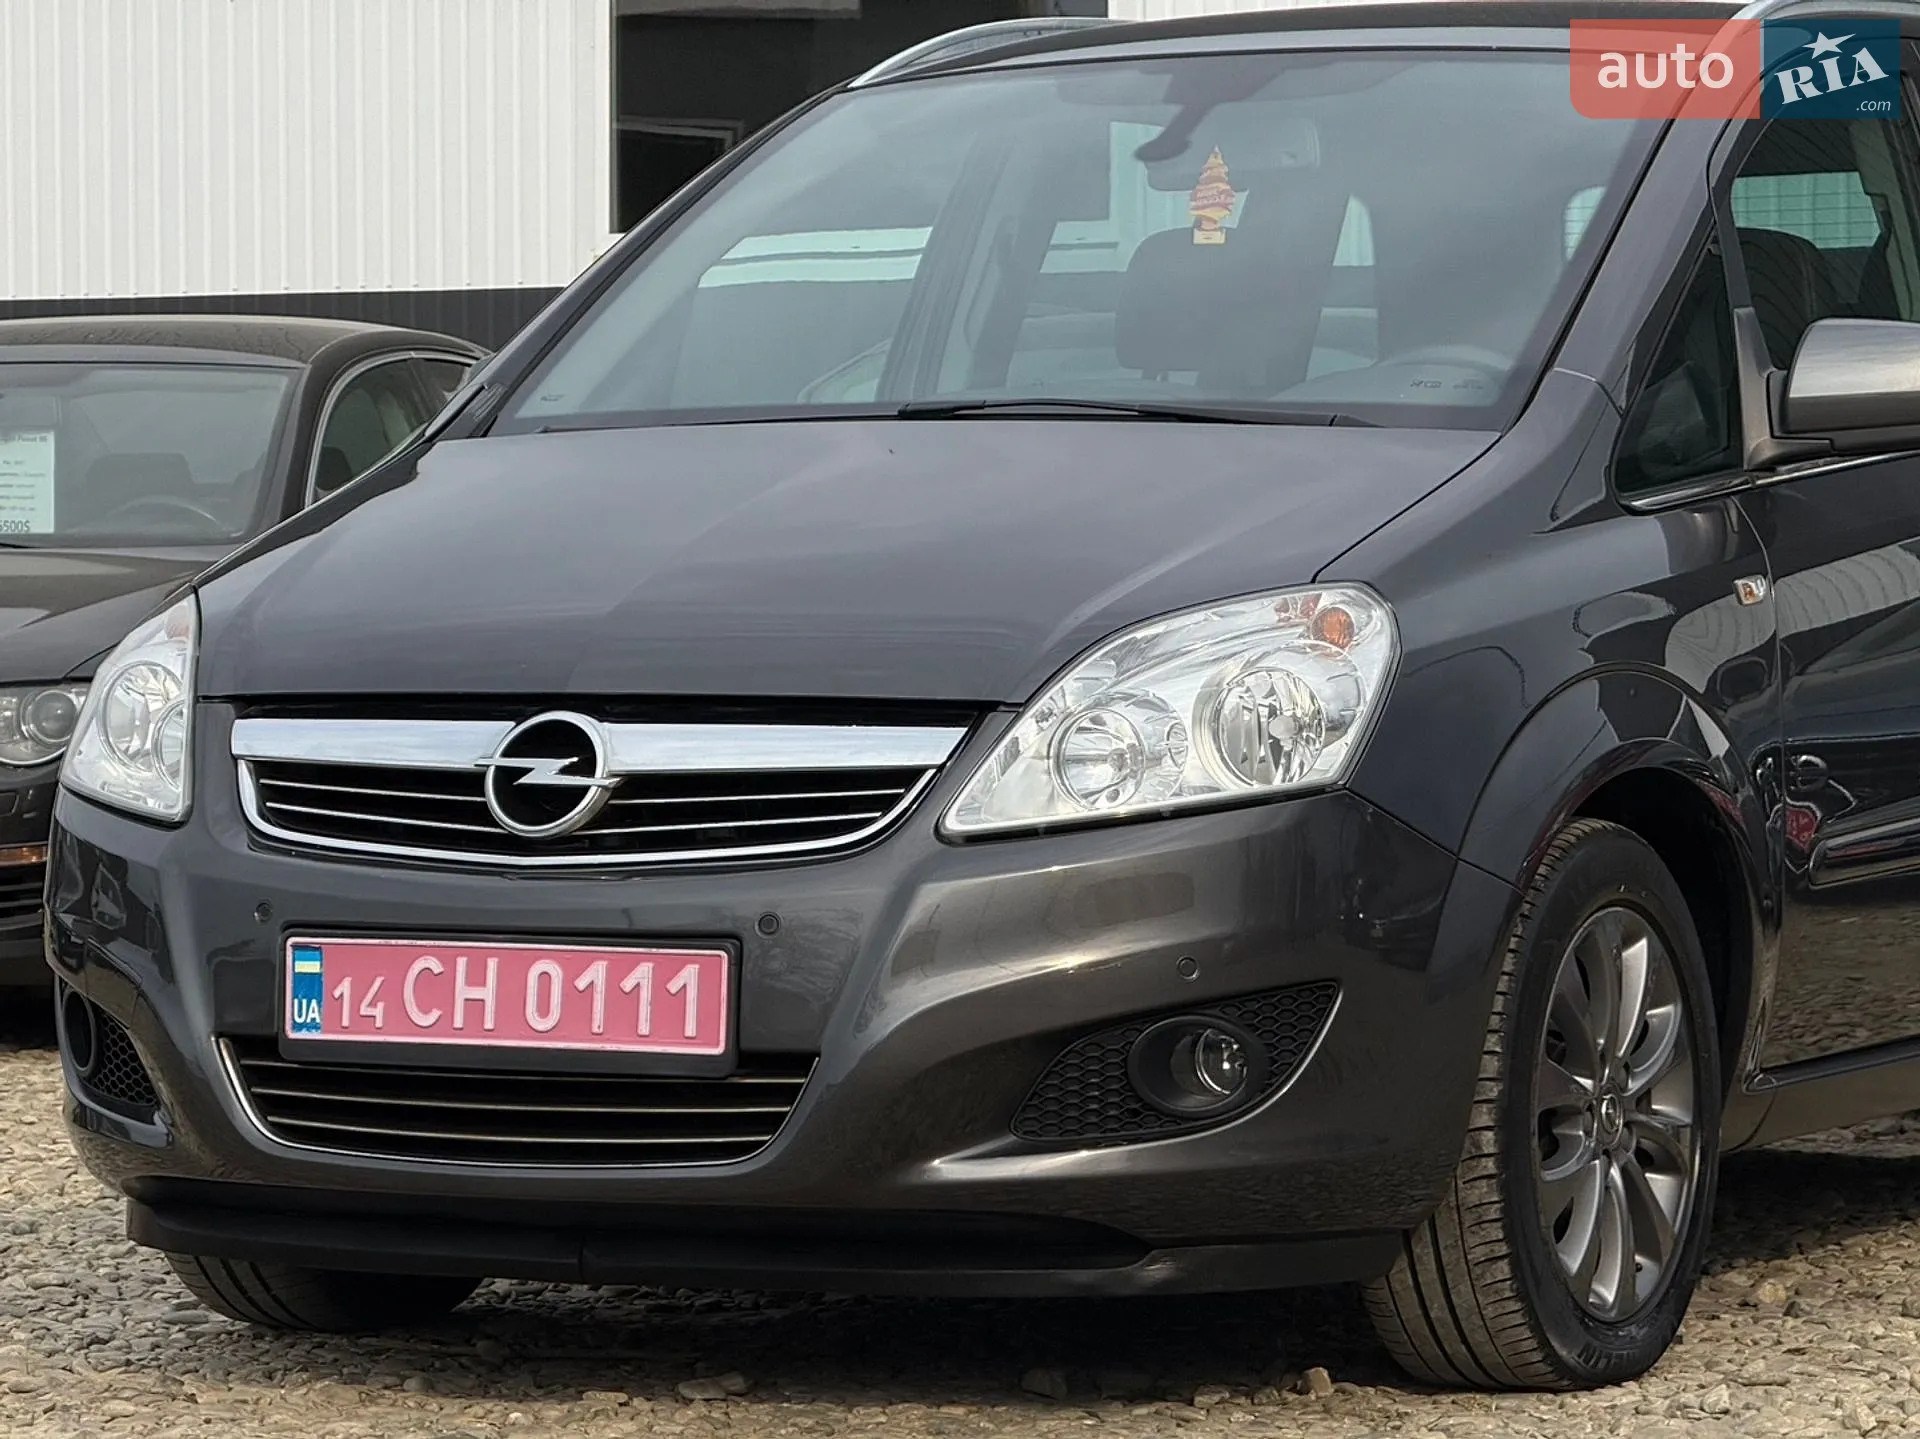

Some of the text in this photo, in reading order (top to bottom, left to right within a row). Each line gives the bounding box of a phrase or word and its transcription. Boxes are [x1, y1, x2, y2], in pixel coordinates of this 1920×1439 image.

[294, 998, 321, 1024] UA
[332, 955, 700, 1038] 14 CH 0111
